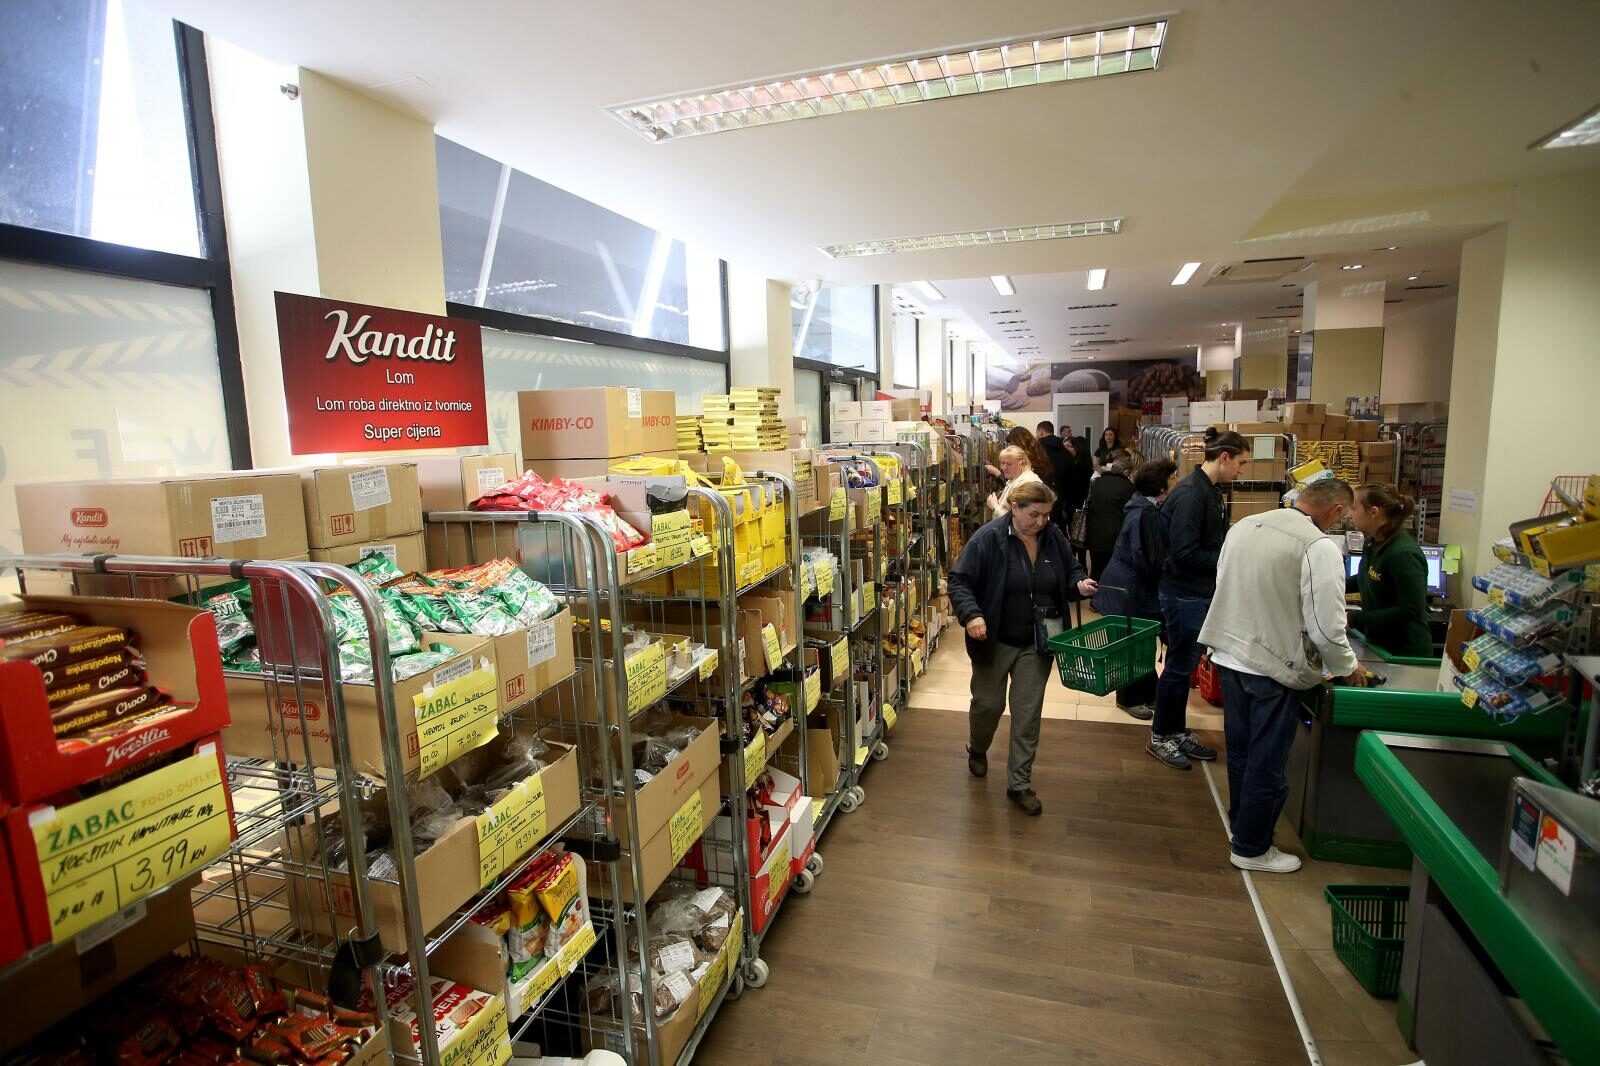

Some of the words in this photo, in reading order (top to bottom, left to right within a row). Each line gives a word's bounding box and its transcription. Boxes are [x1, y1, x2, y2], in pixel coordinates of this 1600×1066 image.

[324, 310, 456, 363] Kandit
[386, 369, 415, 385] Lom
[316, 396, 345, 411] Lom
[349, 397, 375, 411] roba
[378, 398, 422, 412] direktno
[424, 399, 433, 411] iz
[435, 399, 472, 411] tvornice
[531, 416, 594, 431] KIMBY-CO
[642, 415, 671, 427] IMBY-CO
[364, 423, 402, 442] Super
[406, 423, 441, 441] cijena
[76, 511, 103, 524] Kandit
[69, 632, 125, 653] Napolitanke
[65, 654, 123, 676] Napolitanke
[98, 668, 129, 688] Choco
[53, 709, 109, 733] apolitanke
[115, 693, 147, 715] Choco
[420, 692, 458, 720] ZABAC
[105, 728, 172, 768] Koestlin
[49, 800, 136, 853] ZABAC
[141, 788, 173, 809] FOOD
[177, 769, 218, 792] OUTLET
[130, 838, 188, 893] 3,99
[444, 1039, 467, 1066] BAC
